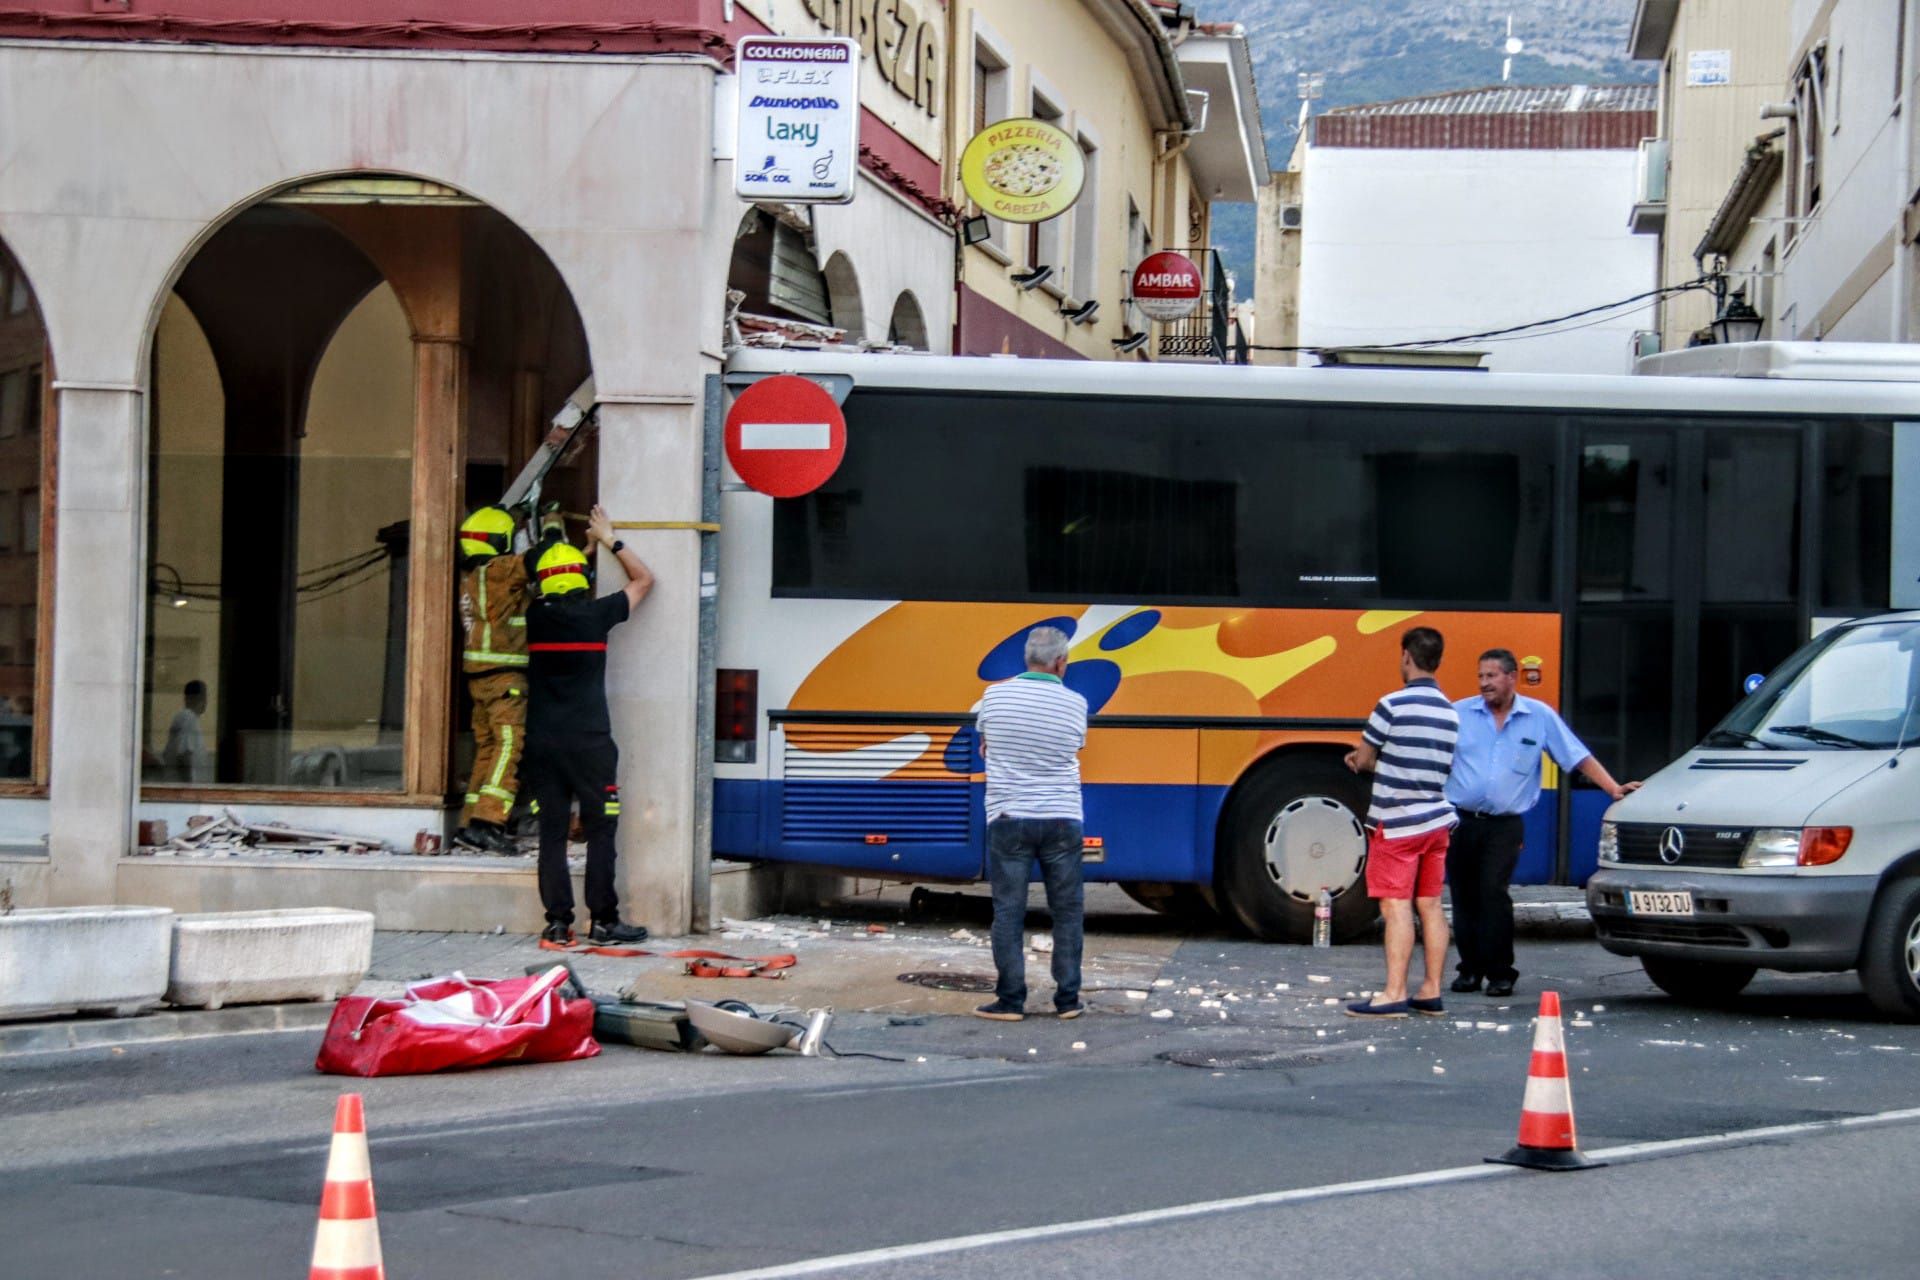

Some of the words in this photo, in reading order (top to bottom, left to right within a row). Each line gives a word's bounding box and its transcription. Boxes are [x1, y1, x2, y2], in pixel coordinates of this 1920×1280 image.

[745, 45, 847, 61] COLCHONERÍA
[767, 116, 819, 148] laxy
[988, 126, 1062, 150] PIZZERIA
[994, 200, 1051, 215] CABEZA
[1137, 273, 1195, 288] AMBAR
[1633, 894, 1640, 911] A
[1643, 894, 1671, 912] 9132
[1675, 894, 1690, 912] DU
